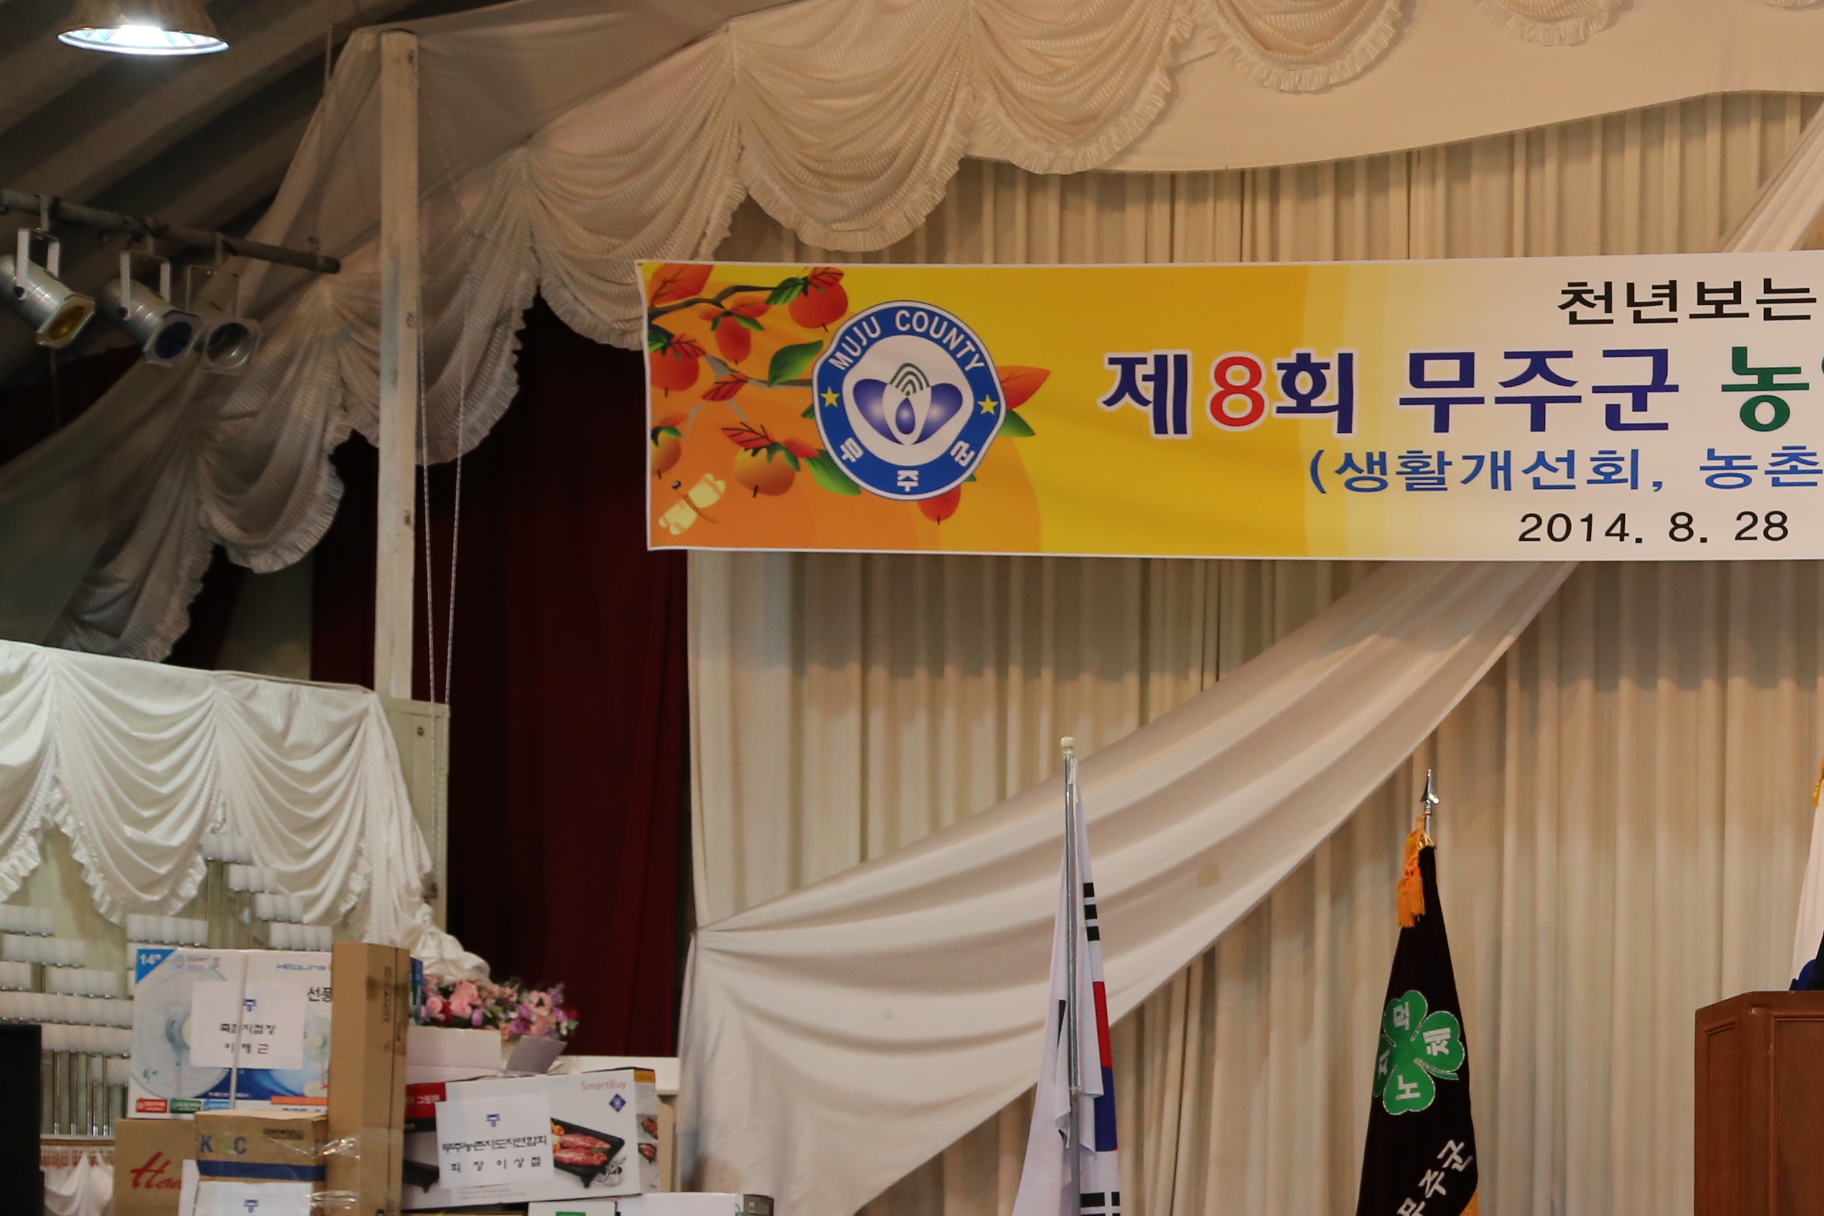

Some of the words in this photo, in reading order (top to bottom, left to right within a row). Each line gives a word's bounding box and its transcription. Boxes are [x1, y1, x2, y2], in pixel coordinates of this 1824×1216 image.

[1557, 278, 1817, 326] 천년보는
[829, 316, 882, 371] MUJU
[895, 309, 985, 372] COUNTY
[1101, 350, 1356, 436] 제8회
[1399, 347, 1680, 434] 무주군
[1309, 447, 1664, 494] (생활개선회,
[1518, 512, 1644, 544] 2014.
[1669, 511, 1708, 543] 8.
[1734, 509, 1789, 542] 28
